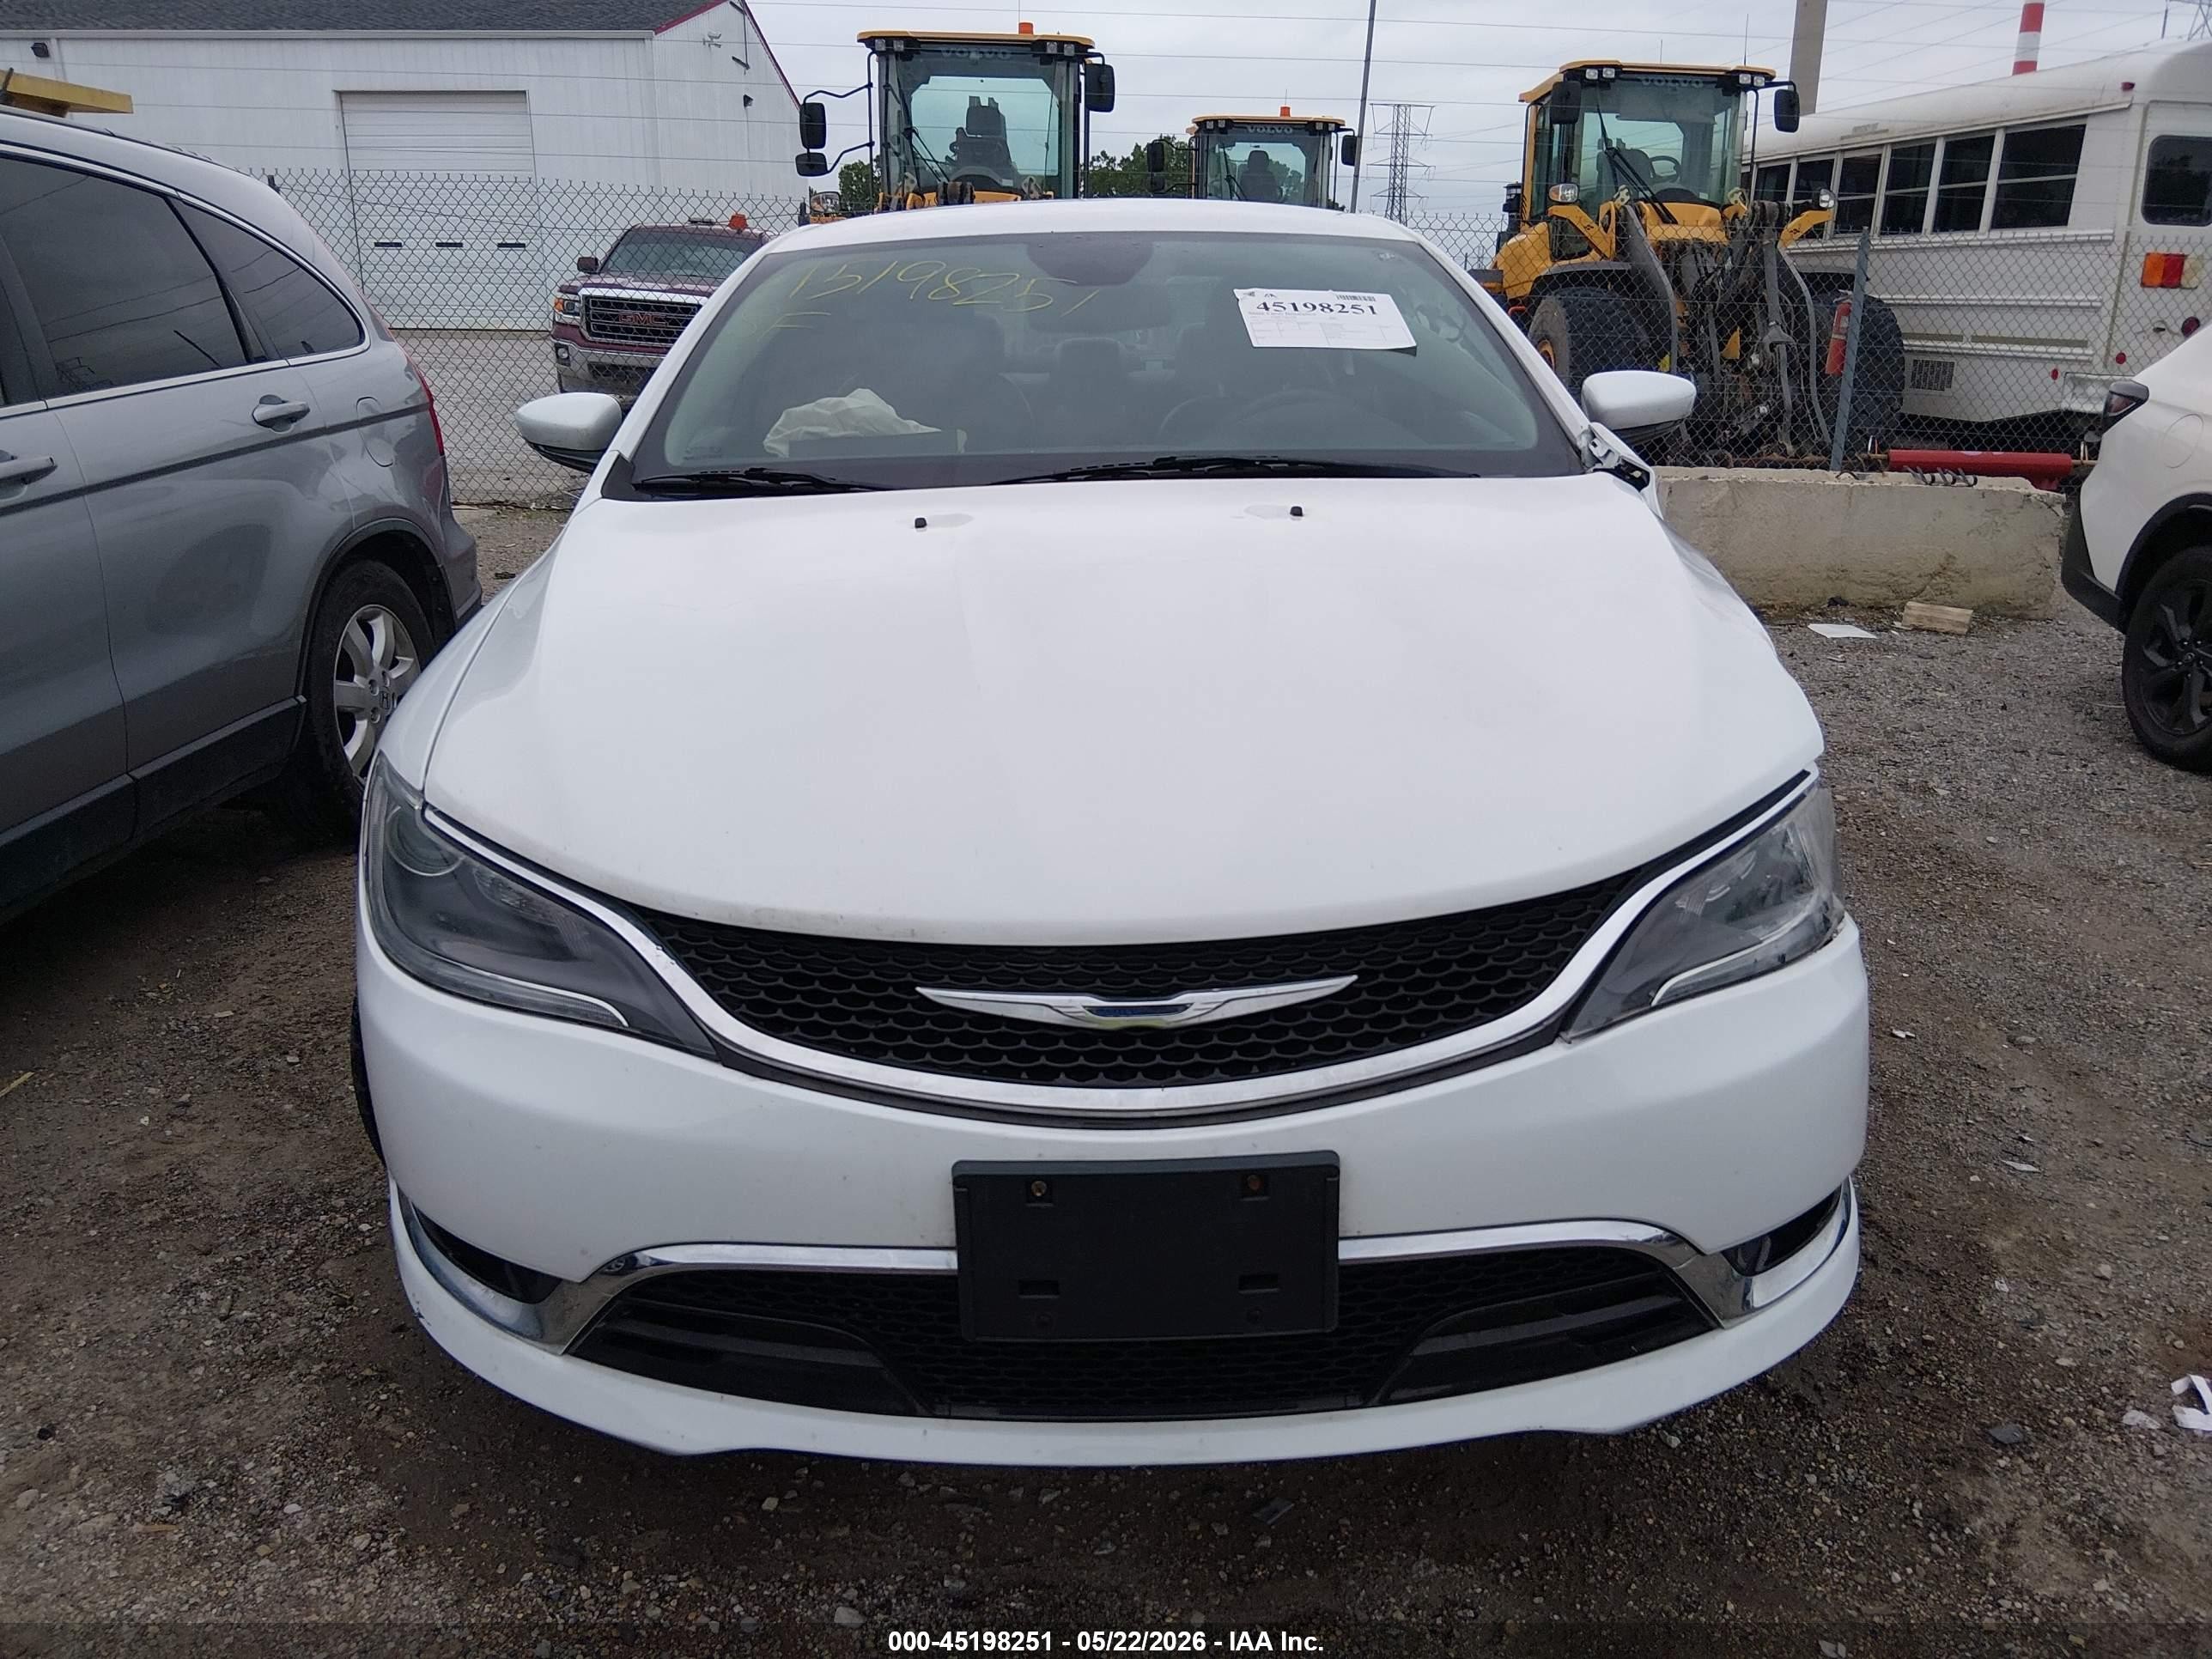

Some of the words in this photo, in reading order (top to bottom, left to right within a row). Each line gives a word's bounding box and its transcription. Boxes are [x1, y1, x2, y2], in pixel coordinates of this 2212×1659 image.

[941, 47, 1012, 60] VOLVO
[1638, 75, 1704, 88] VOLVO
[1247, 125, 1293, 134] VOLVO
[1256, 301, 1377, 315] 45198251
[618, 311, 667, 326] GMC
